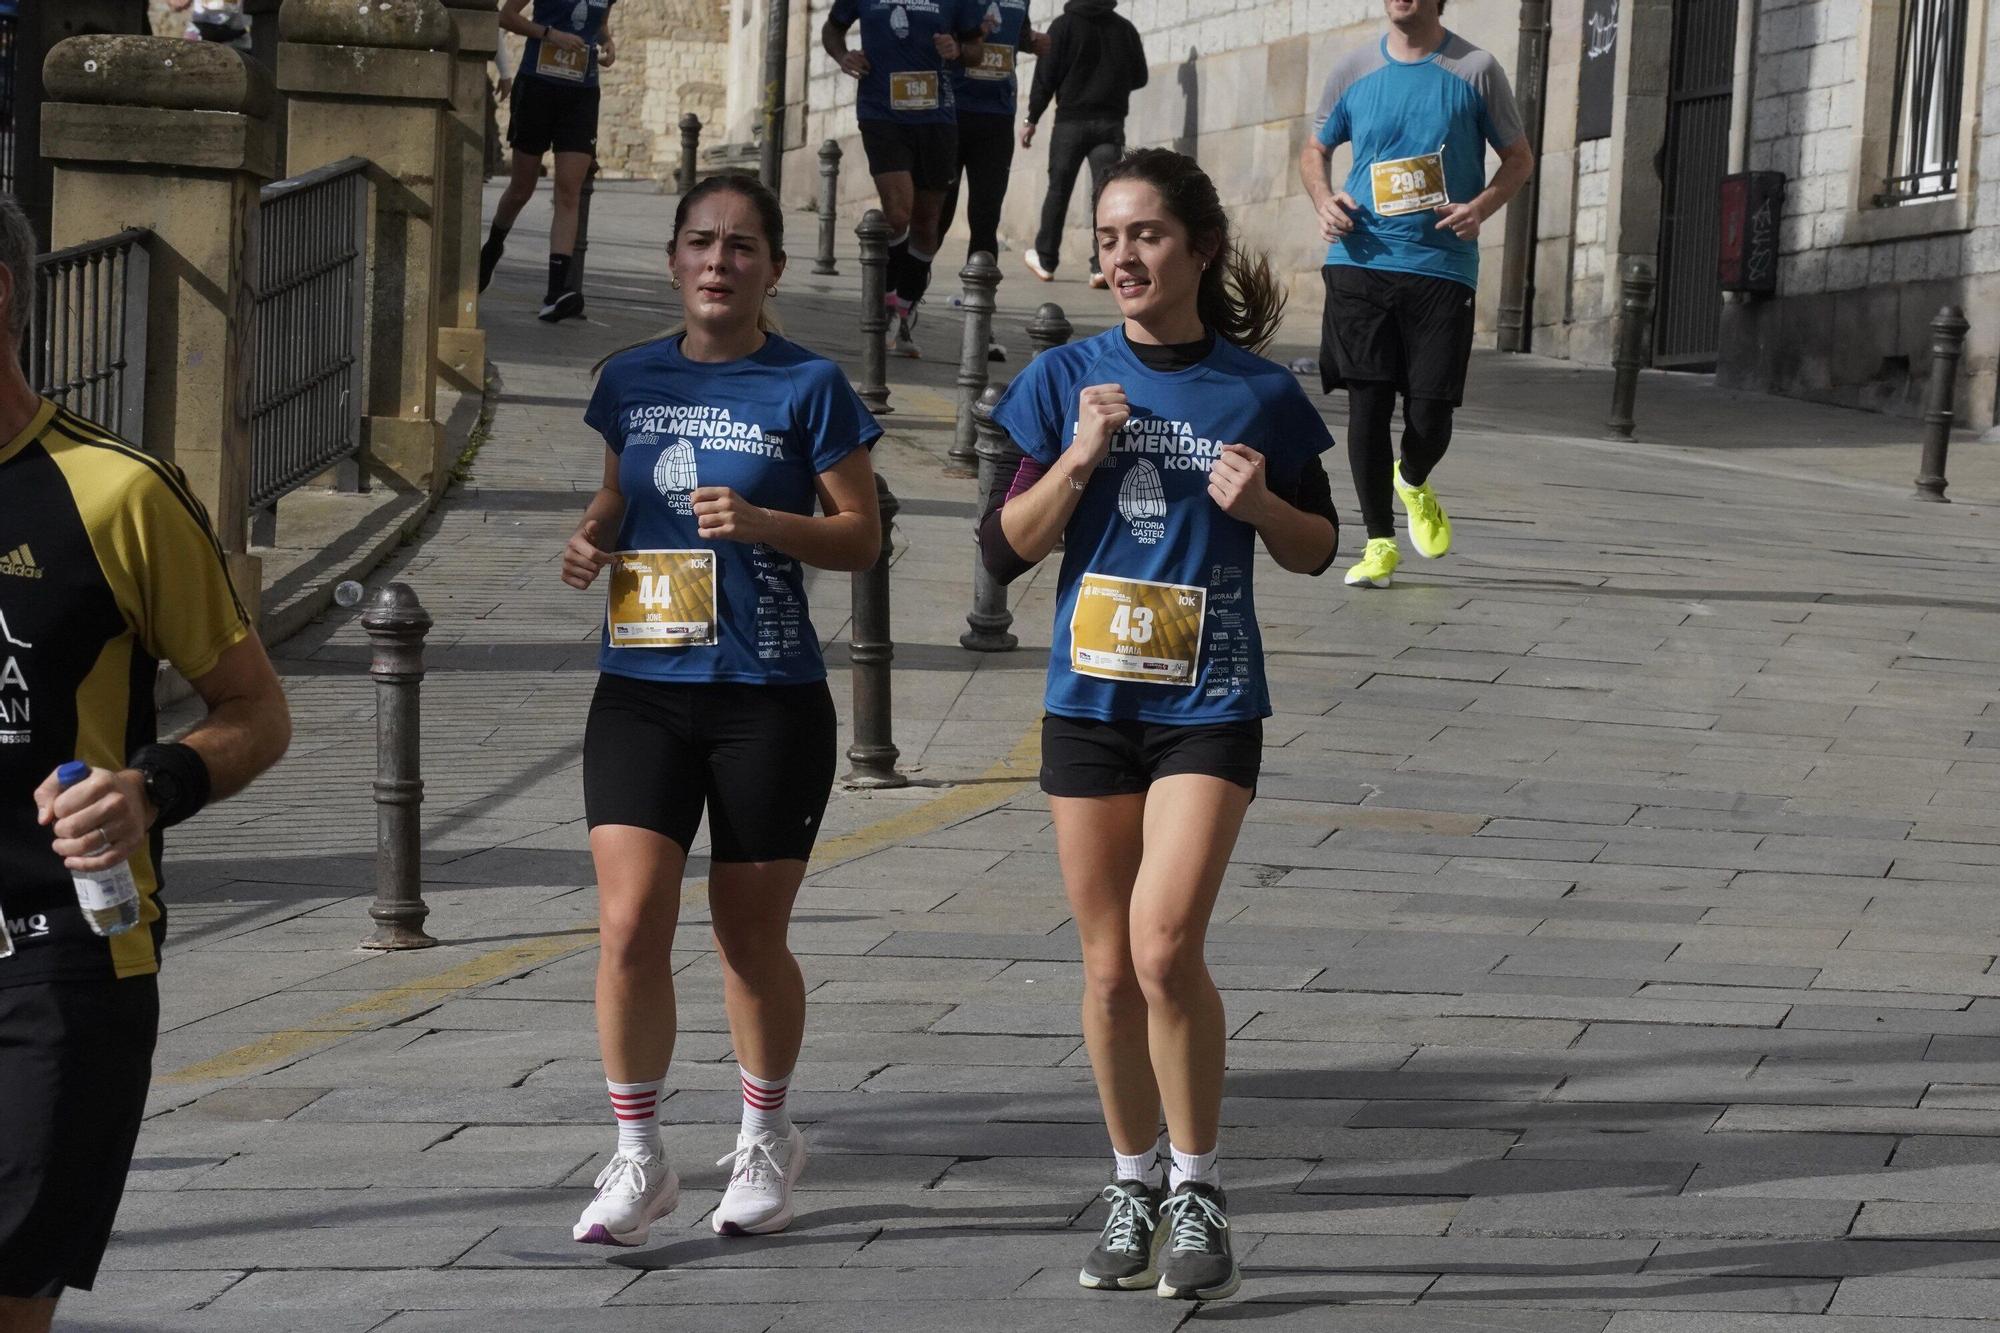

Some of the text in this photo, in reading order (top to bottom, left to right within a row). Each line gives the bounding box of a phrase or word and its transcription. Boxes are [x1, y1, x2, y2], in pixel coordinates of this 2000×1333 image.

[554, 49, 577, 65] 421
[905, 80, 928, 96] 158
[1391, 169, 1426, 194] 298
[630, 405, 730, 421] LA CONQUISTA
[642, 418, 763, 441] ALMENDRA
[764, 434, 784, 444] REN
[1117, 420, 1193, 435] NQUISTA
[700, 438, 784, 460] KONKISTA
[1111, 434, 1224, 457] LMENDRA
[1164, 455, 1214, 472] KONK
[667, 493, 692, 502] VITOR
[668, 501, 693, 510] GASTE
[1131, 520, 1165, 530] VITORIA
[1131, 529, 1165, 538] GASTEIZ
[1138, 537, 1156, 545] 2025
[0, 563, 43, 578] didas
[690, 558, 708, 569] 10K
[638, 575, 671, 609] 44
[1178, 595, 1196, 607] 10K
[1110, 604, 1154, 643] 43
[1115, 645, 1142, 655] AMAIA
